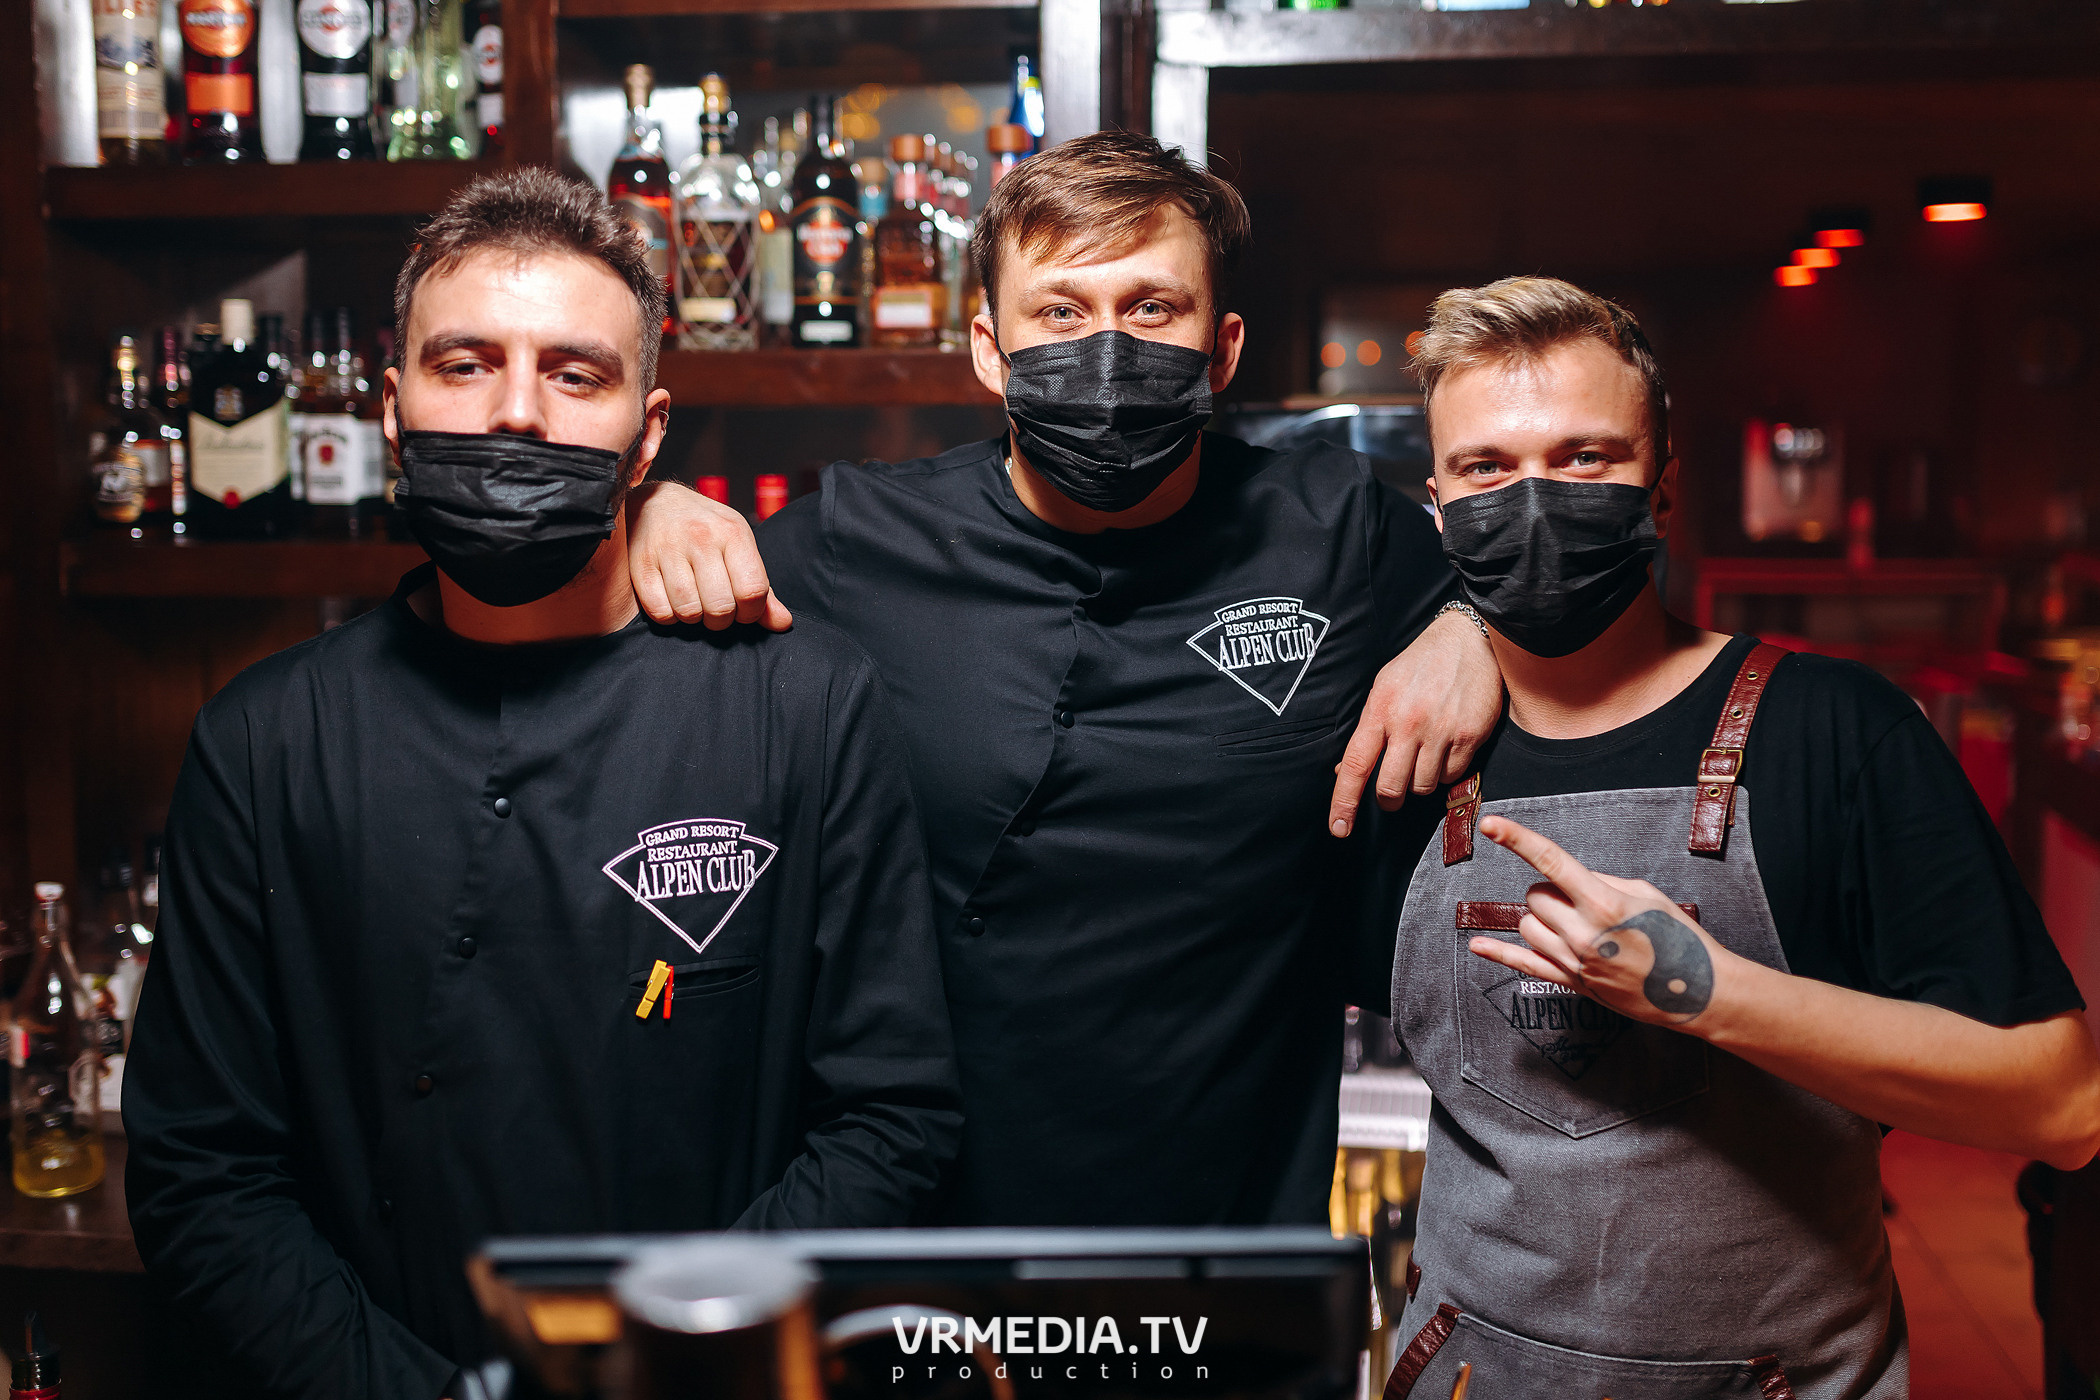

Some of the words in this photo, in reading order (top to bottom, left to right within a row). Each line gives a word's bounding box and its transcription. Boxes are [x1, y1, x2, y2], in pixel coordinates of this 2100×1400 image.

[1221, 605, 1257, 623] GRAND
[1258, 602, 1298, 614] RESORT
[1225, 616, 1298, 636] RESTAURANT
[1218, 634, 1276, 671] ALPEN
[1276, 623, 1316, 662] CLUB
[645, 827, 689, 847] GRAND
[691, 825, 740, 838] RESORT
[647, 841, 738, 862] RESTAURANT
[635, 860, 704, 902] ALPEN
[706, 849, 756, 893] CLUB
[1520, 981, 1577, 995] RESTAU
[1511, 992, 1574, 1030] ALPEN
